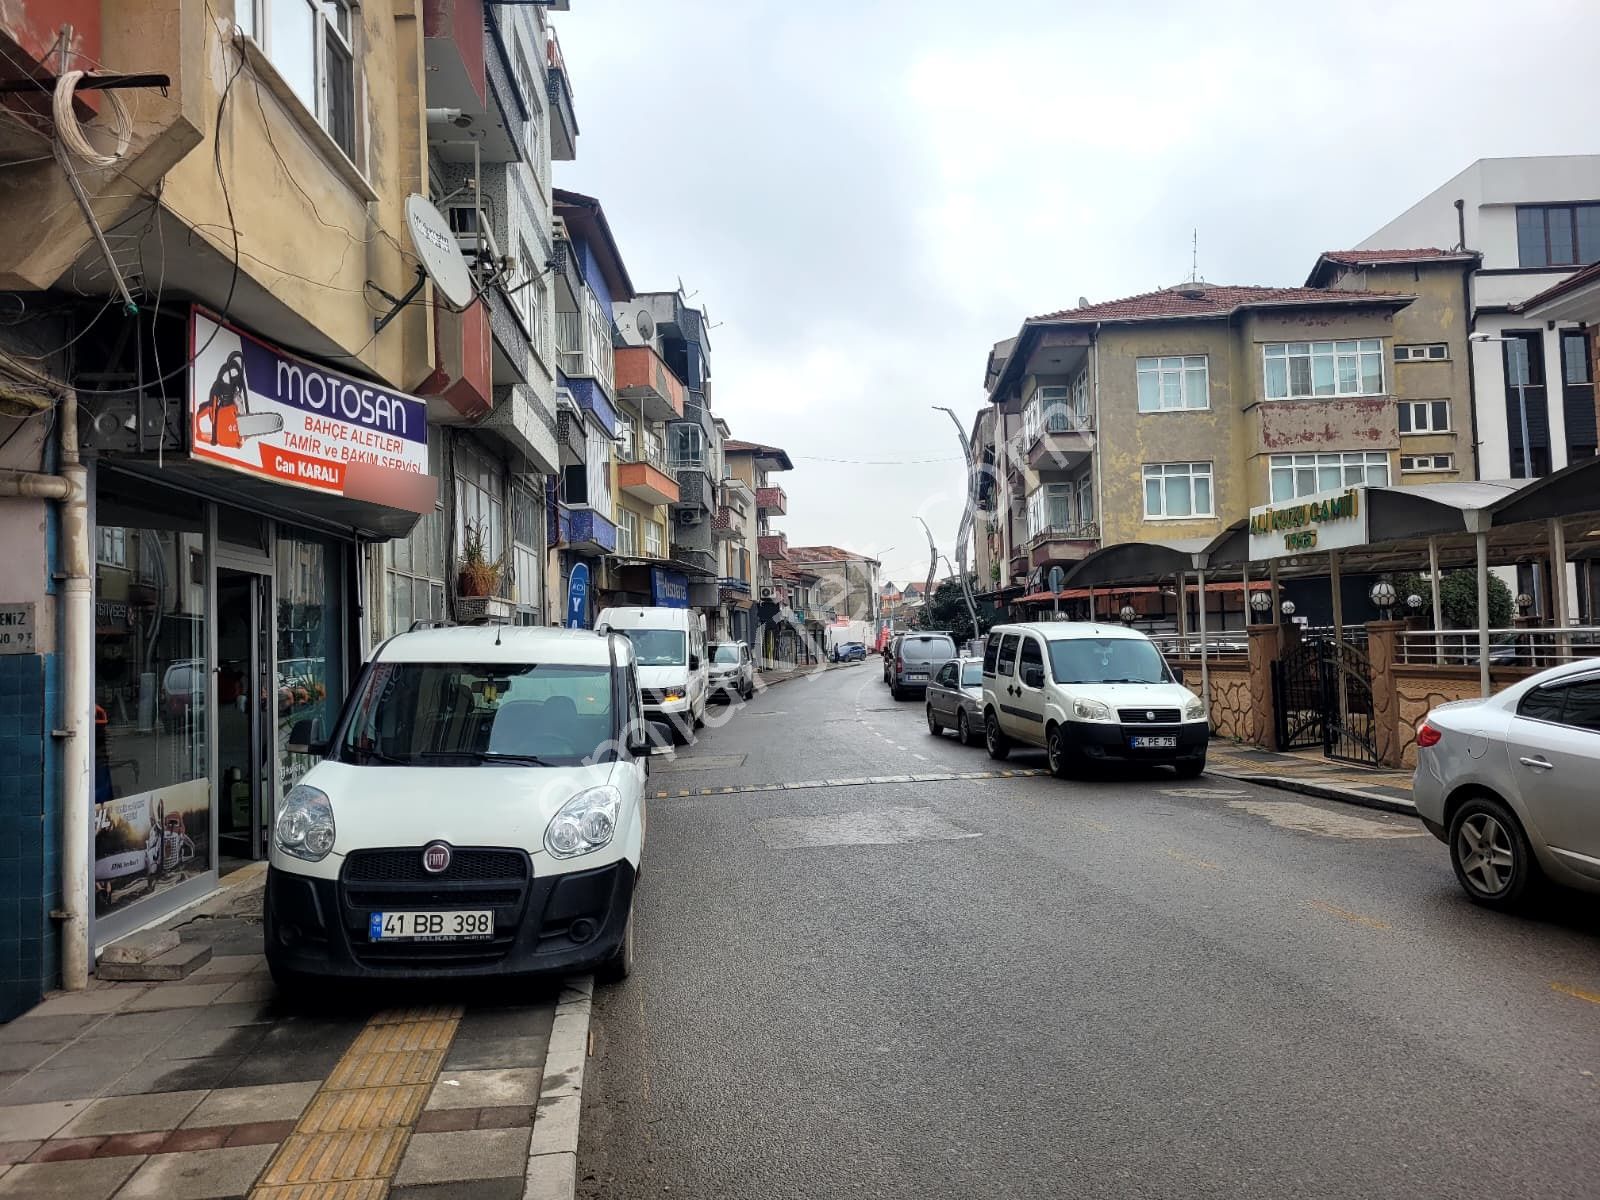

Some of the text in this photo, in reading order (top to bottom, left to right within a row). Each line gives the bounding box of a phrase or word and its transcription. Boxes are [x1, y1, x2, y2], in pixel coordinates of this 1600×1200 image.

[284, 431, 321, 455] TAMİR
[325, 444, 338, 458] ve
[304, 416, 404, 455] BAHÇE ALETLERİ
[275, 456, 339, 484] Can KARALI
[429, 853, 445, 866] FIAT
[384, 914, 489, 934] 41 BB 398
